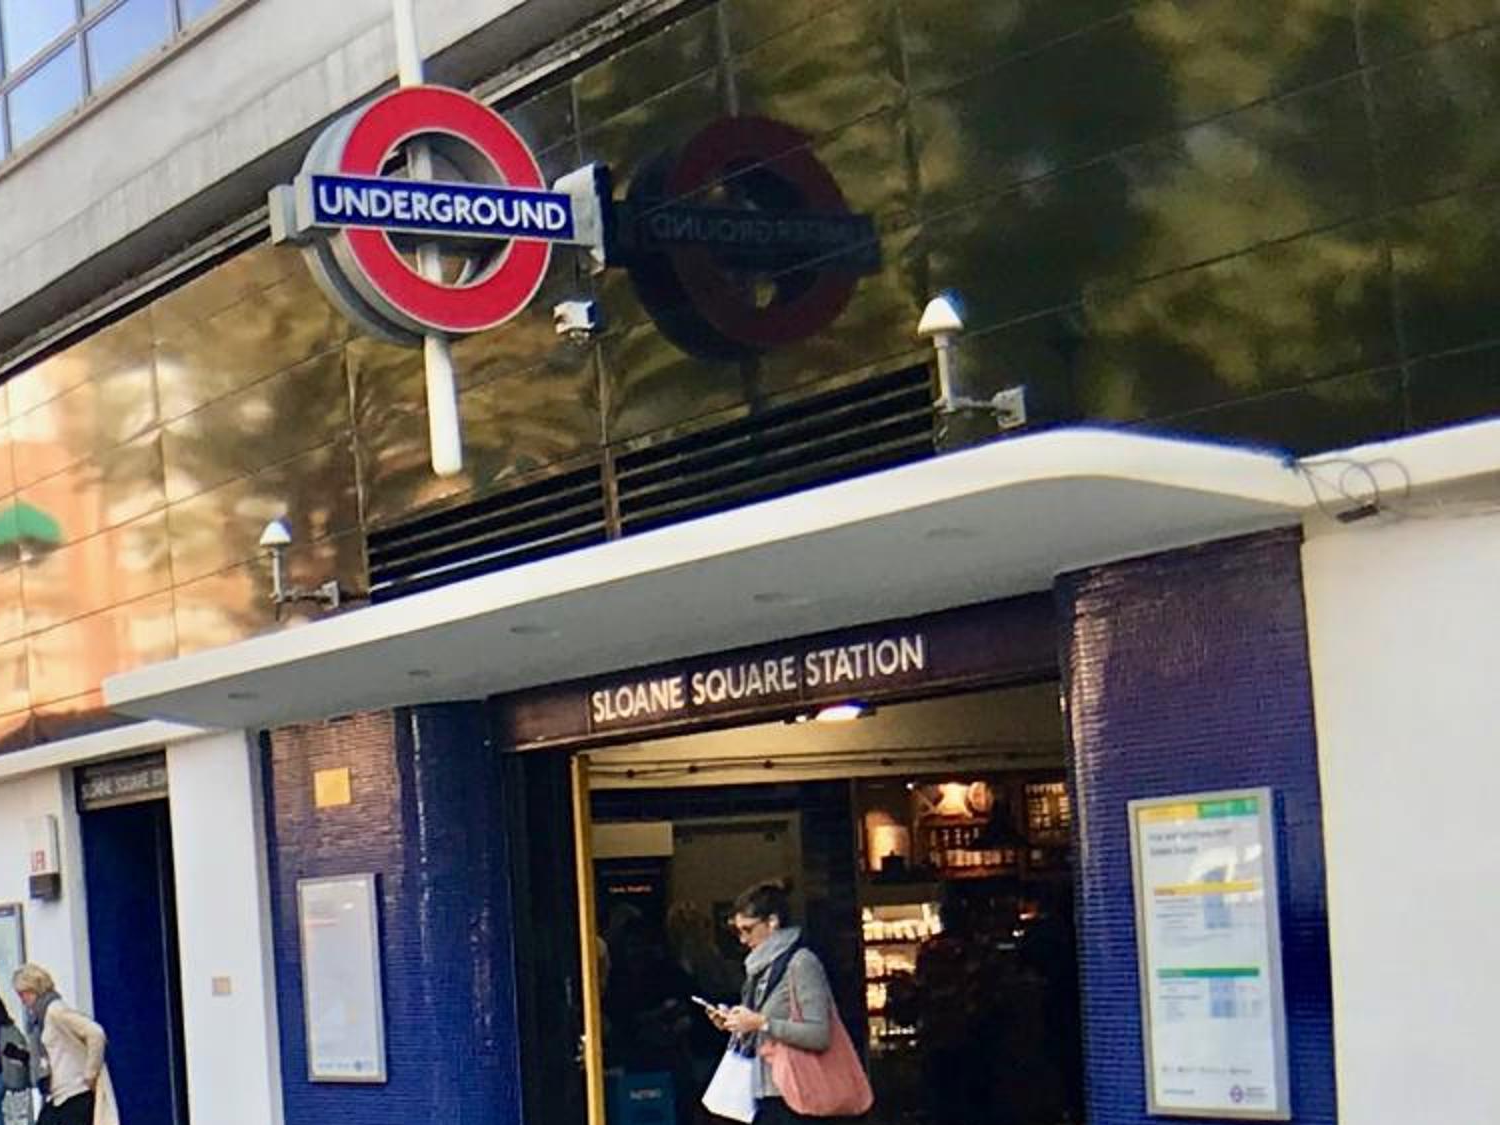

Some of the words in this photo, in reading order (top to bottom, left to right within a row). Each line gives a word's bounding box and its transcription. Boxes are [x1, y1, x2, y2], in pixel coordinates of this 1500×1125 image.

[319, 185, 566, 231] UNDERGROUND
[592, 677, 685, 723] SLOANE
[692, 656, 796, 705] SQUARE
[804, 634, 924, 687] STATION
